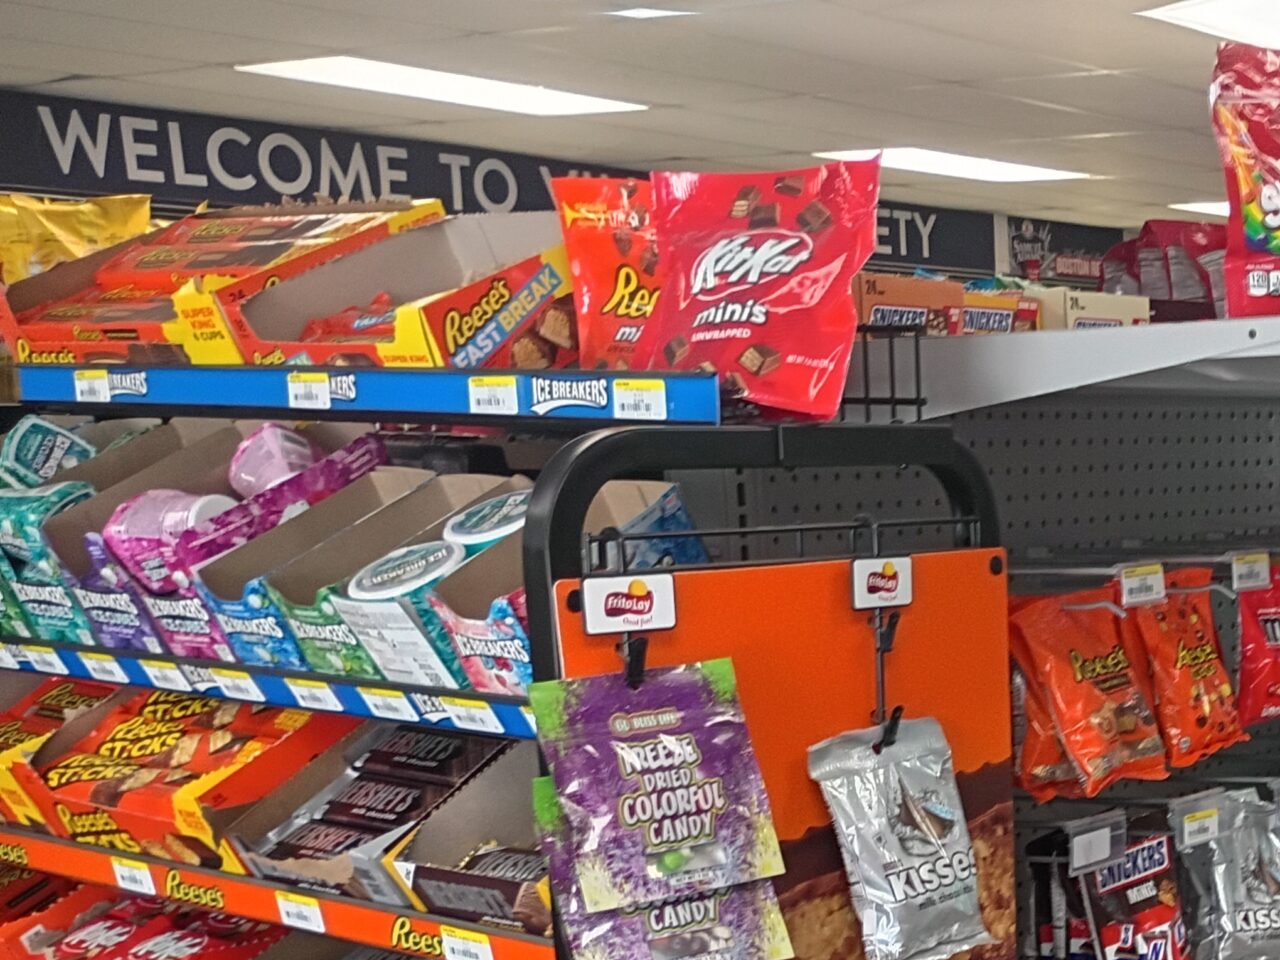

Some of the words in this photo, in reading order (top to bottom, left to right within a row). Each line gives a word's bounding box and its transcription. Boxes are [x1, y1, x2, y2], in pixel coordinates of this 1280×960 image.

[37, 105, 411, 202] WELCOME
[438, 154, 517, 214] TO
[865, 279, 877, 294] 24
[181, 307, 215, 319] SUPER
[190, 319, 216, 330] KING
[445, 279, 512, 354] Reese's
[453, 325, 501, 370] FAST
[500, 265, 562, 330] BREAK
[693, 299, 767, 329] minis
[872, 306, 926, 326] SNICKERS
[963, 308, 1012, 332] SNICKERS
[690, 327, 752, 343] UNWRAPPED
[532, 377, 551, 403] ICE
[551, 378, 608, 406] BREAKERS
[605, 594, 654, 616] FritoLay
[474, 637, 530, 663] BREAKERS
[143, 699, 221, 721] STICKS
[98, 732, 182, 758] STICKS
[47, 764, 142, 788] STICKS
[642, 770, 692, 793] DRIED
[620, 781, 726, 829] COLORFUL
[648, 811, 716, 848] CANDY
[1097, 838, 1168, 891] SNICKERS
[166, 869, 224, 908] Reese's
[647, 900, 719, 933] CANDY
